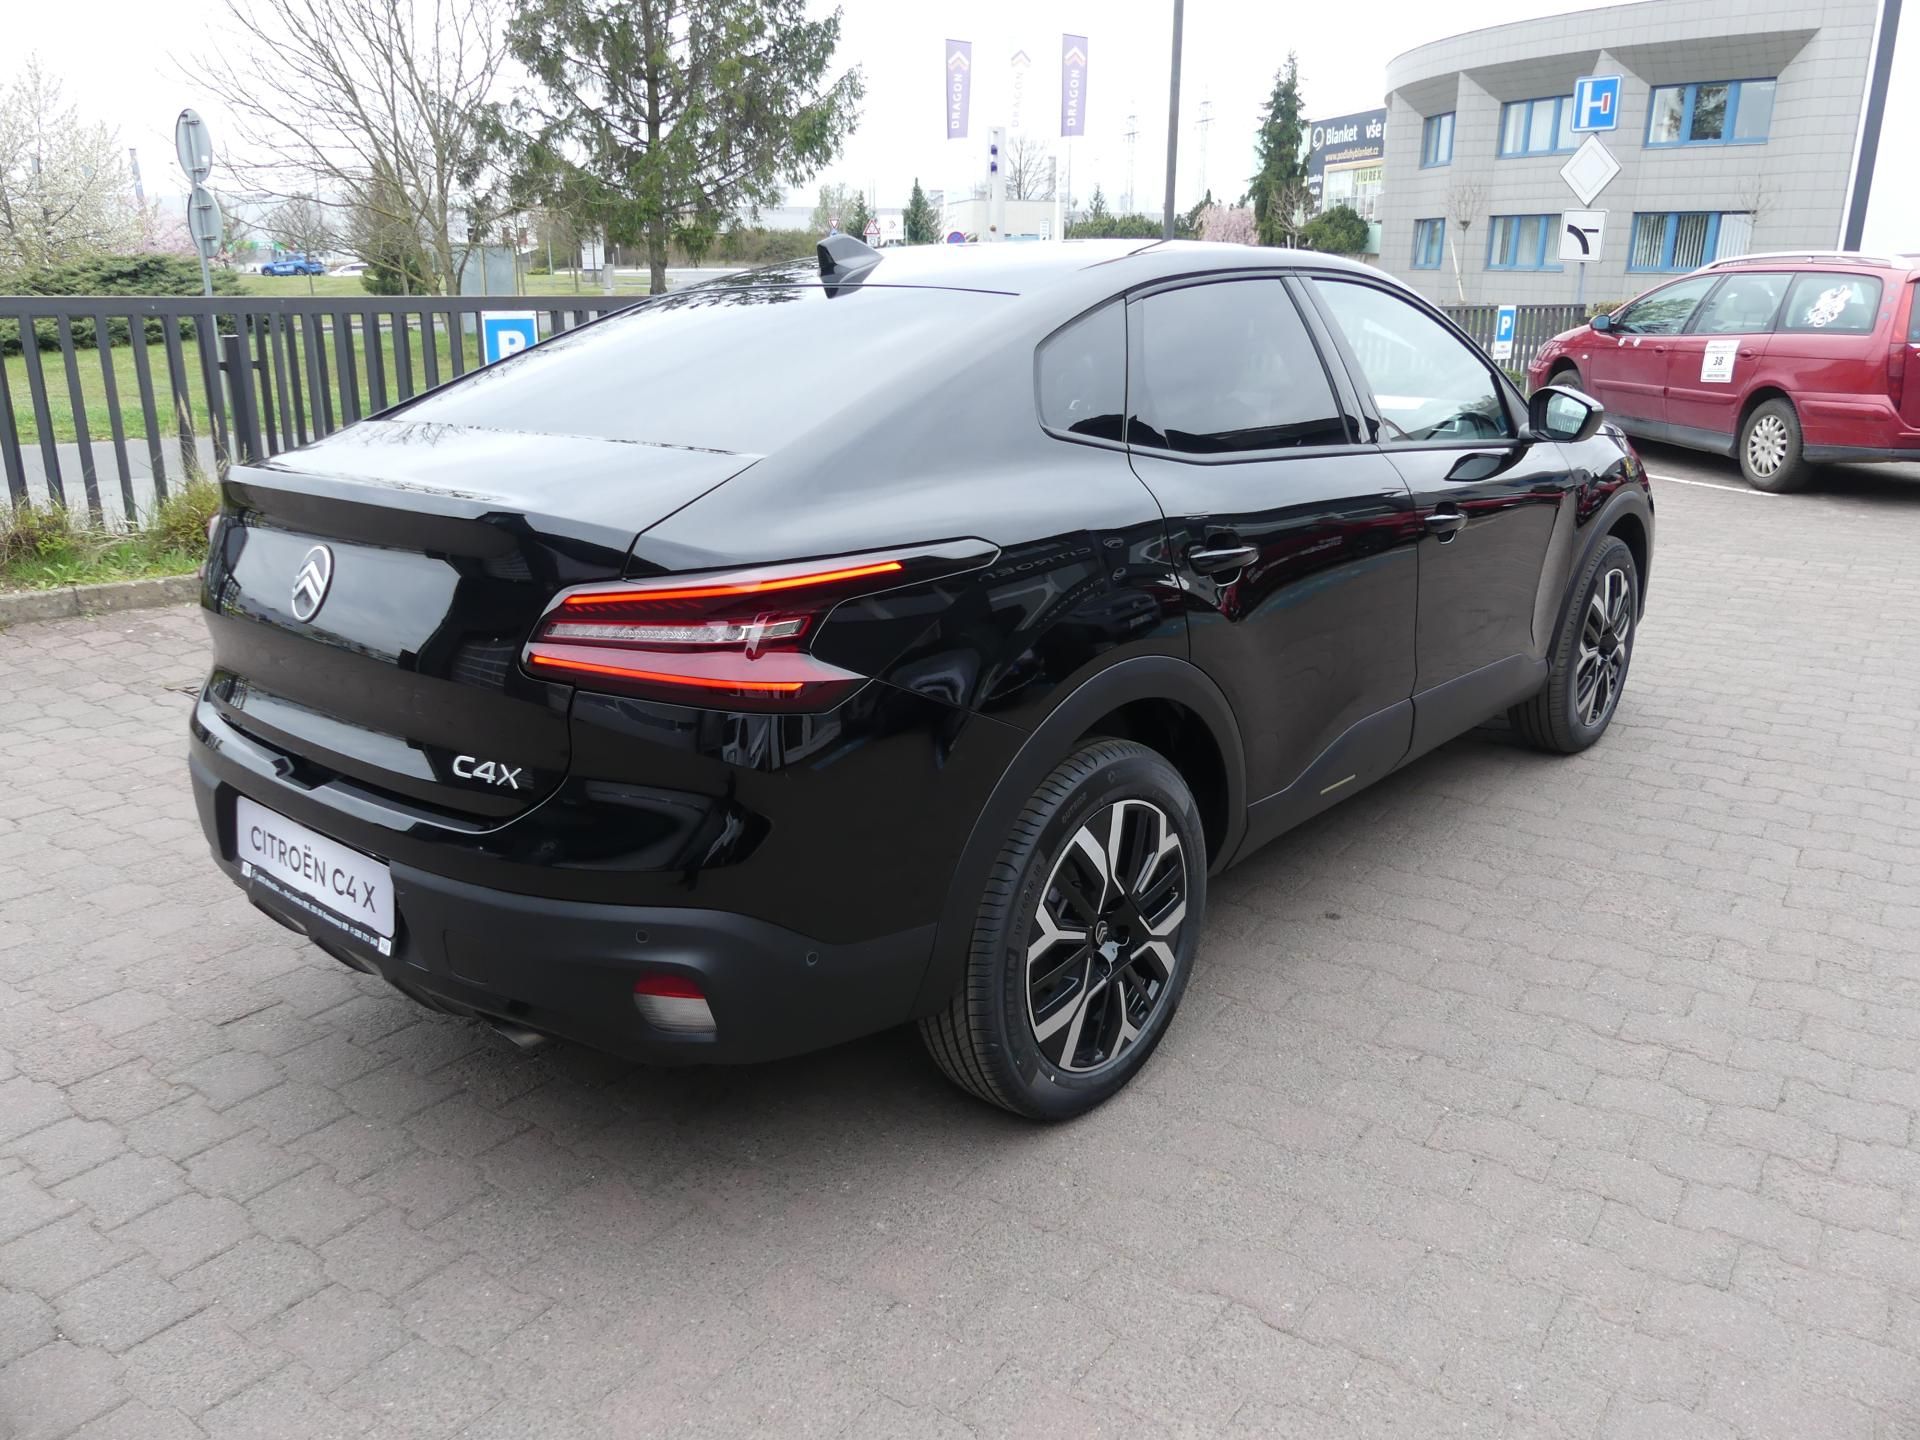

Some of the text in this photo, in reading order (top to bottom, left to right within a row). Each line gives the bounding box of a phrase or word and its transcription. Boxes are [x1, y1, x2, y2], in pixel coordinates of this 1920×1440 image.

[951, 73, 963, 129] DRAGON
[1067, 69, 1080, 127] DRAGON
[1326, 124, 1358, 146] Blanket
[1366, 119, 1382, 139] vše
[498, 330, 526, 359] P
[1500, 315, 1511, 336] P
[251, 825, 326, 887] CITROËN
[332, 868, 357, 903] C4
[362, 881, 376, 913] X
